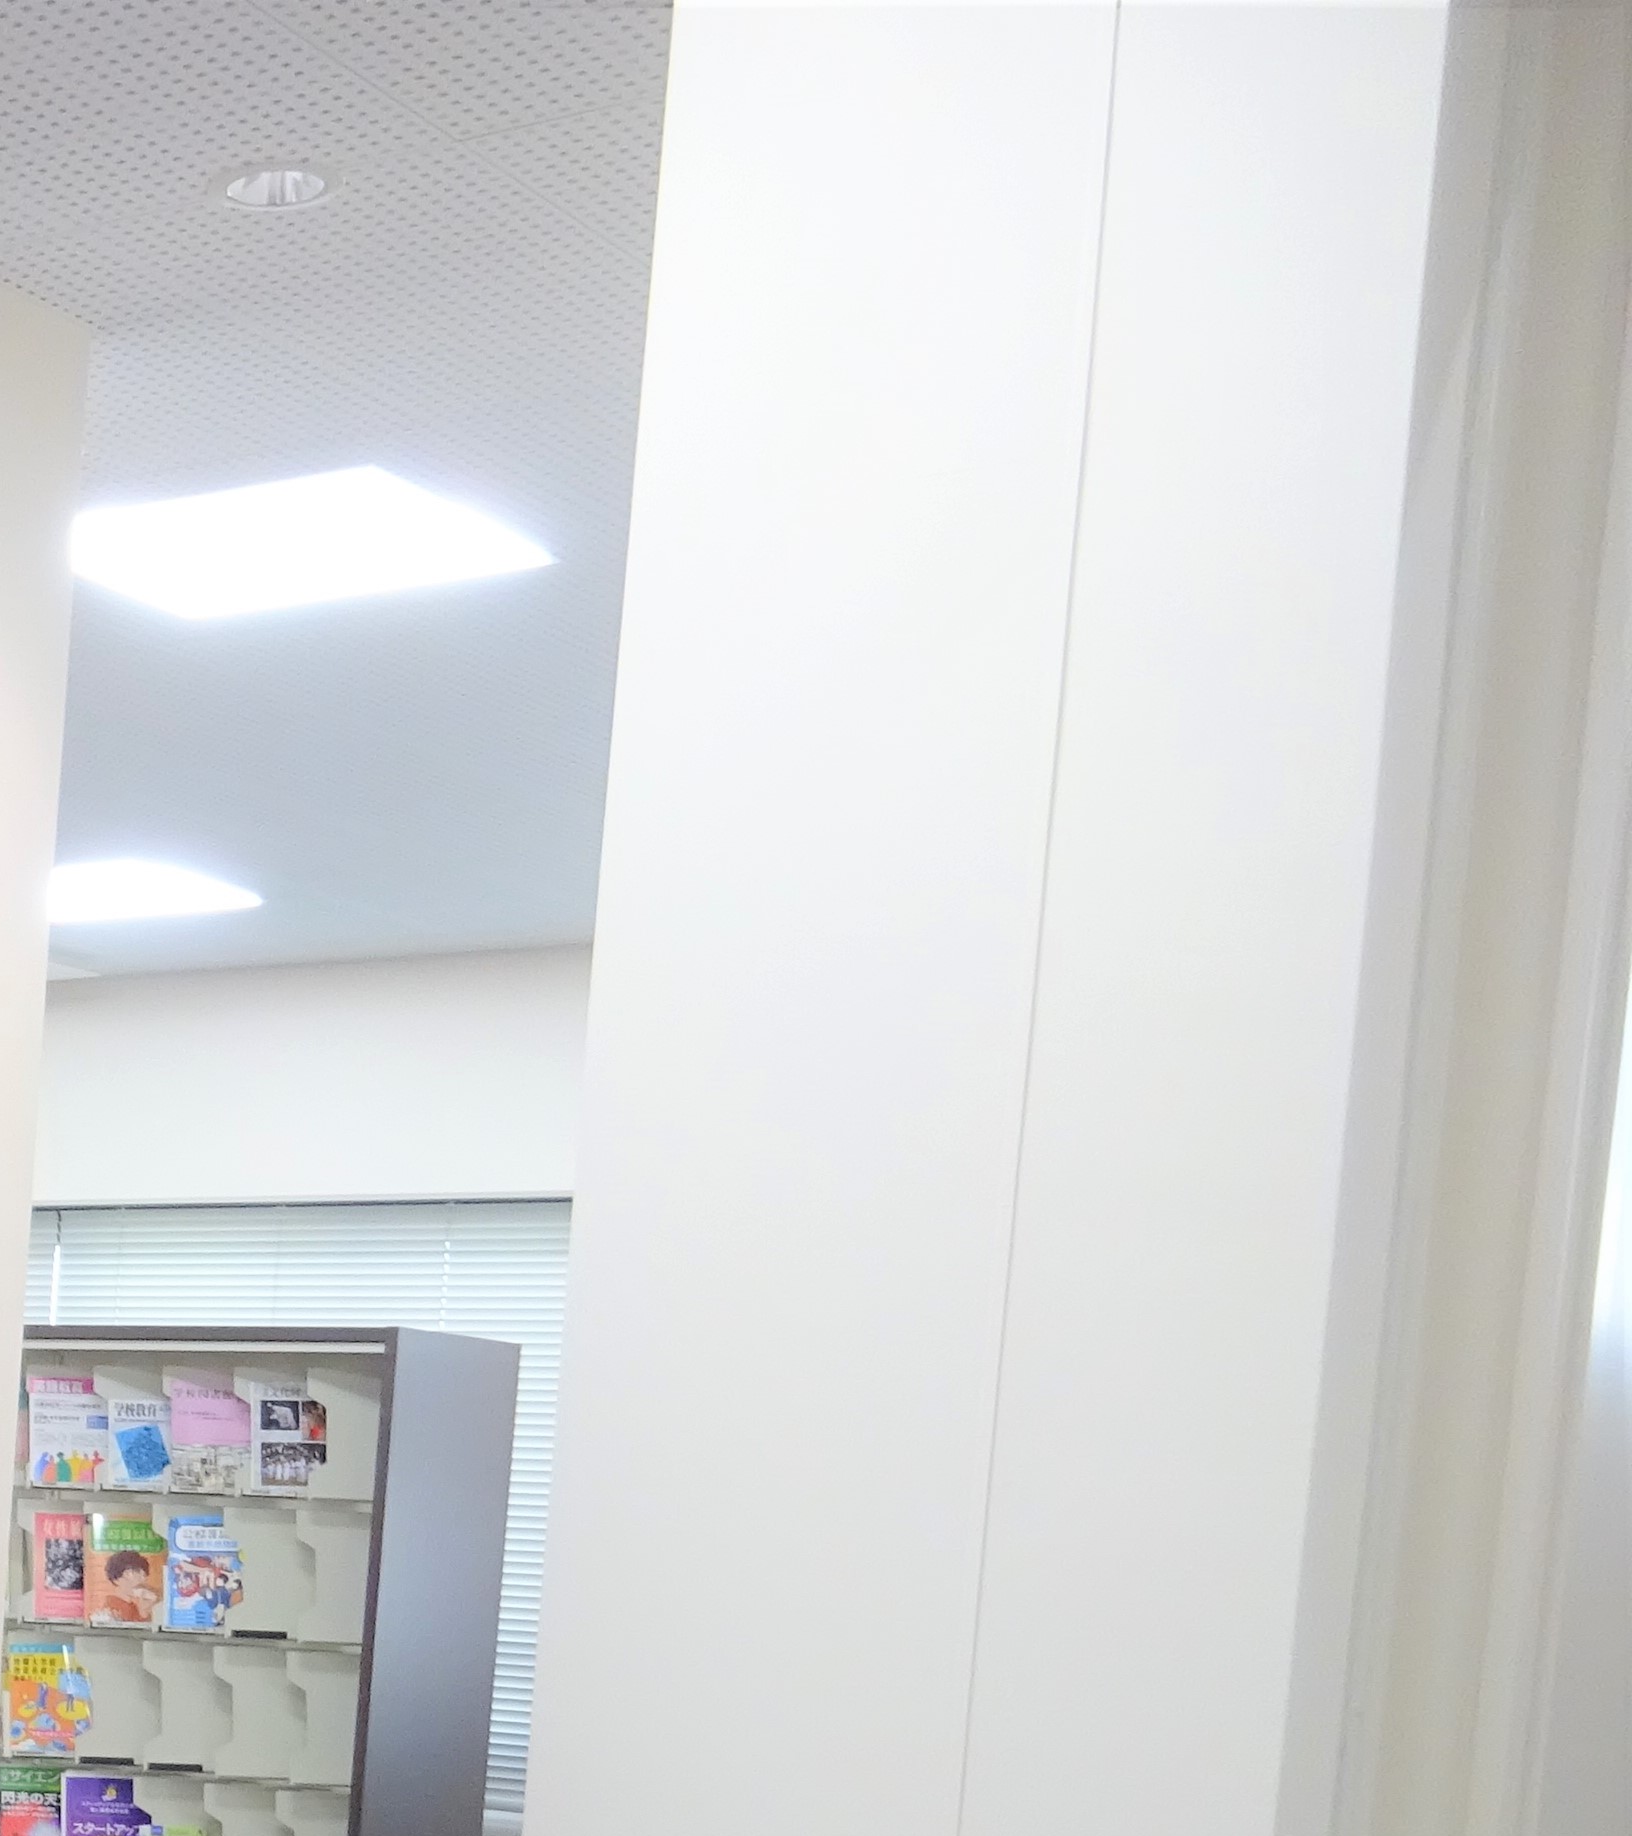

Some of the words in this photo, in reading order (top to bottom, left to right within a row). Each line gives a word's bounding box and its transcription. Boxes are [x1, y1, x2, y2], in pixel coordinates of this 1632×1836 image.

[0, 1790, 61, 1807] 閃光の天
[72, 1821, 139, 1836] スタートアッ
